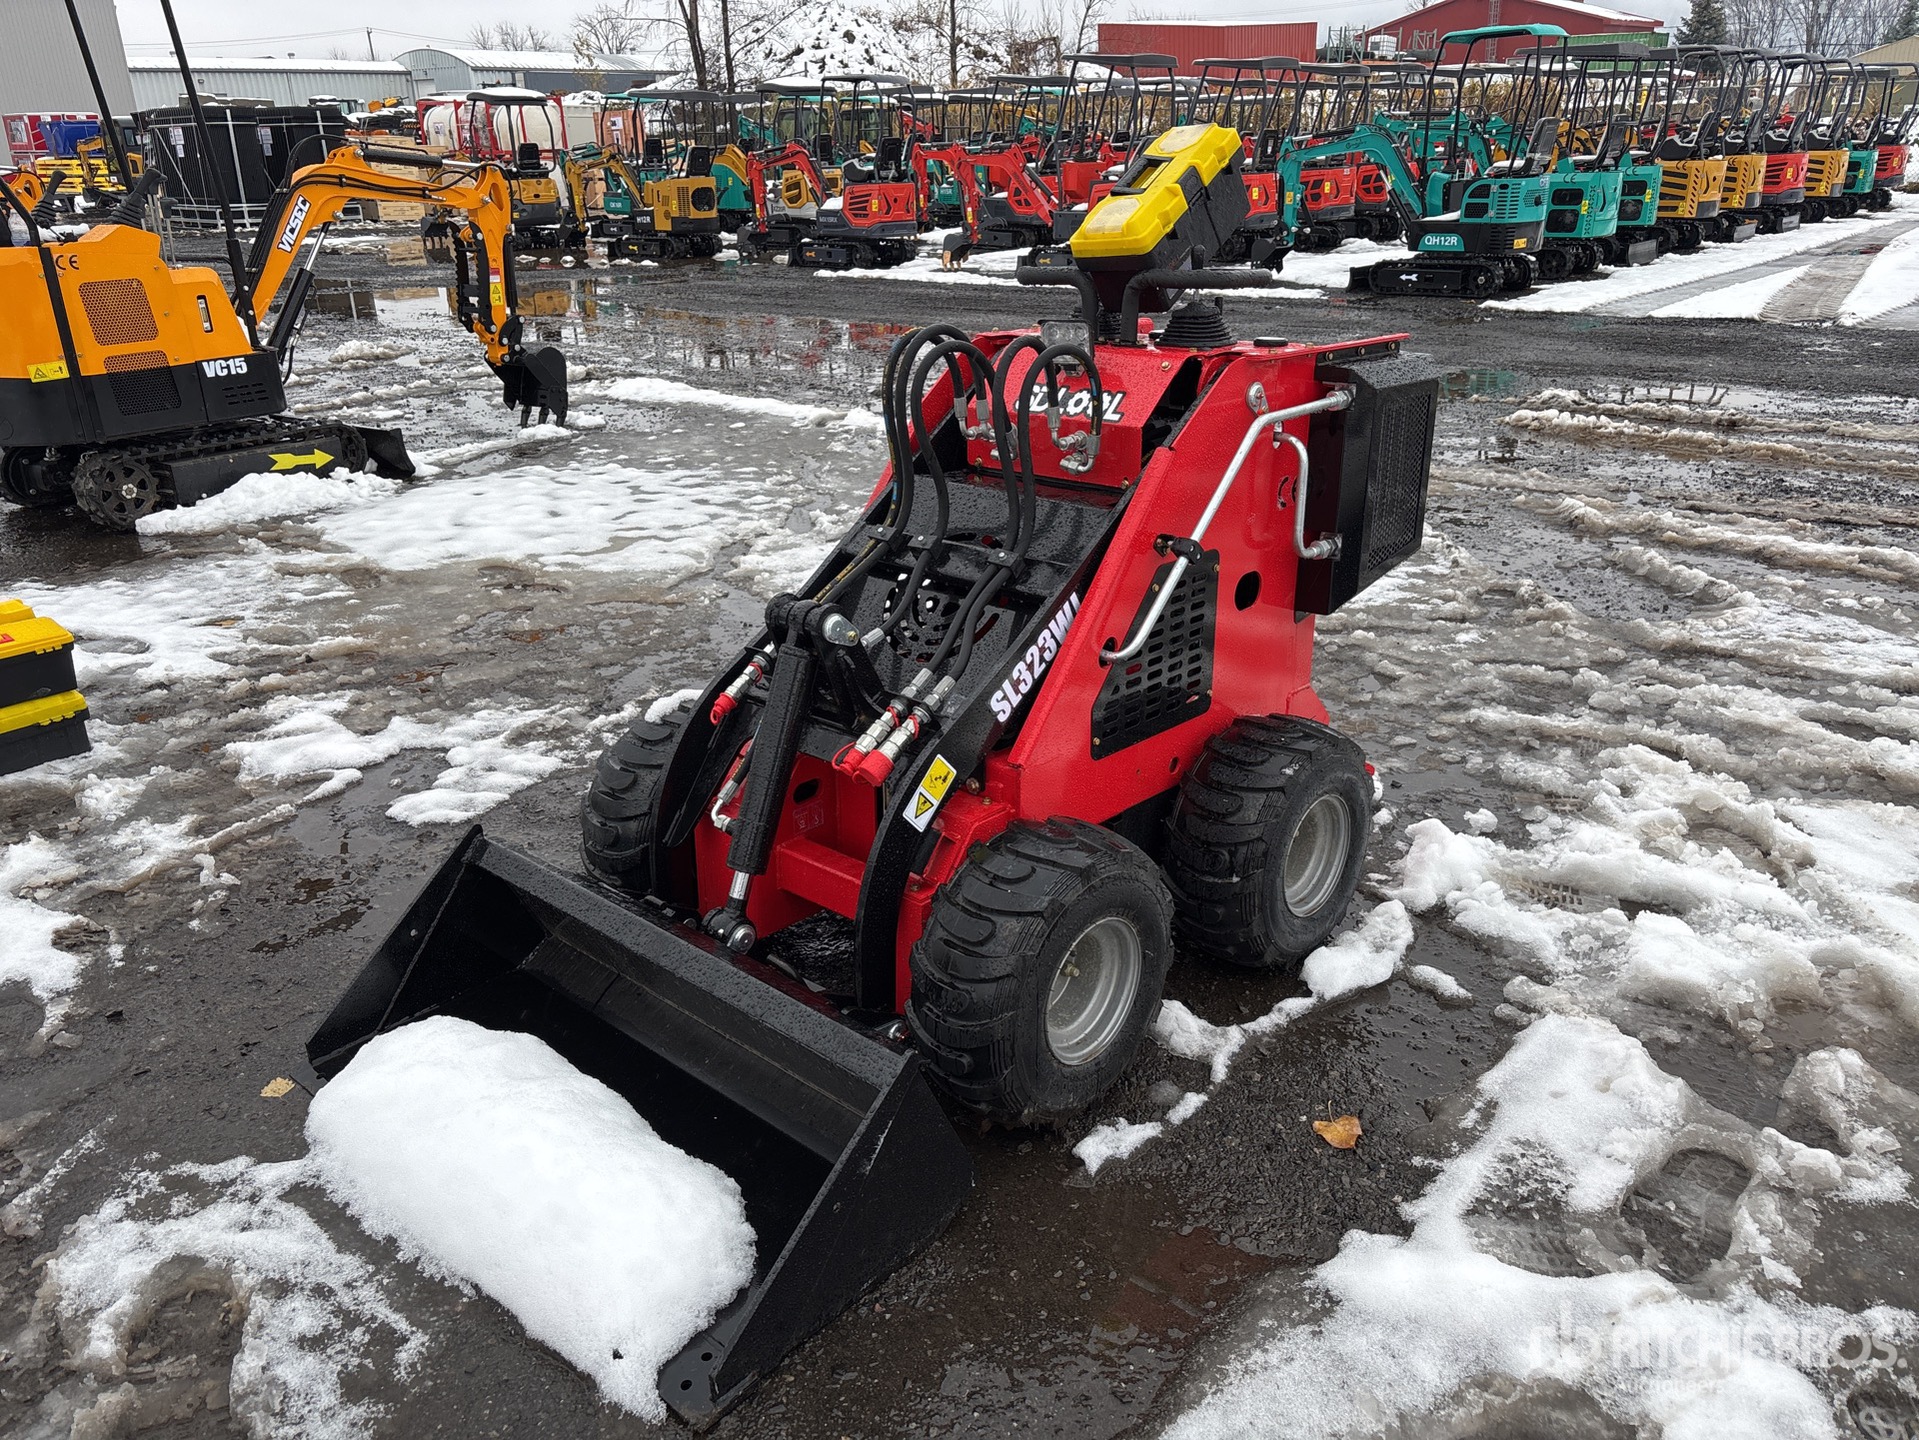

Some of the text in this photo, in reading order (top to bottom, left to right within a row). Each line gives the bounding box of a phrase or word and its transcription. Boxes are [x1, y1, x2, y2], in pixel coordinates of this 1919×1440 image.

[277, 194, 312, 253] VICSEC
[636, 216, 651, 224] H12R
[1424, 235, 1458, 246] QH12R
[202, 357, 248, 378] VC15
